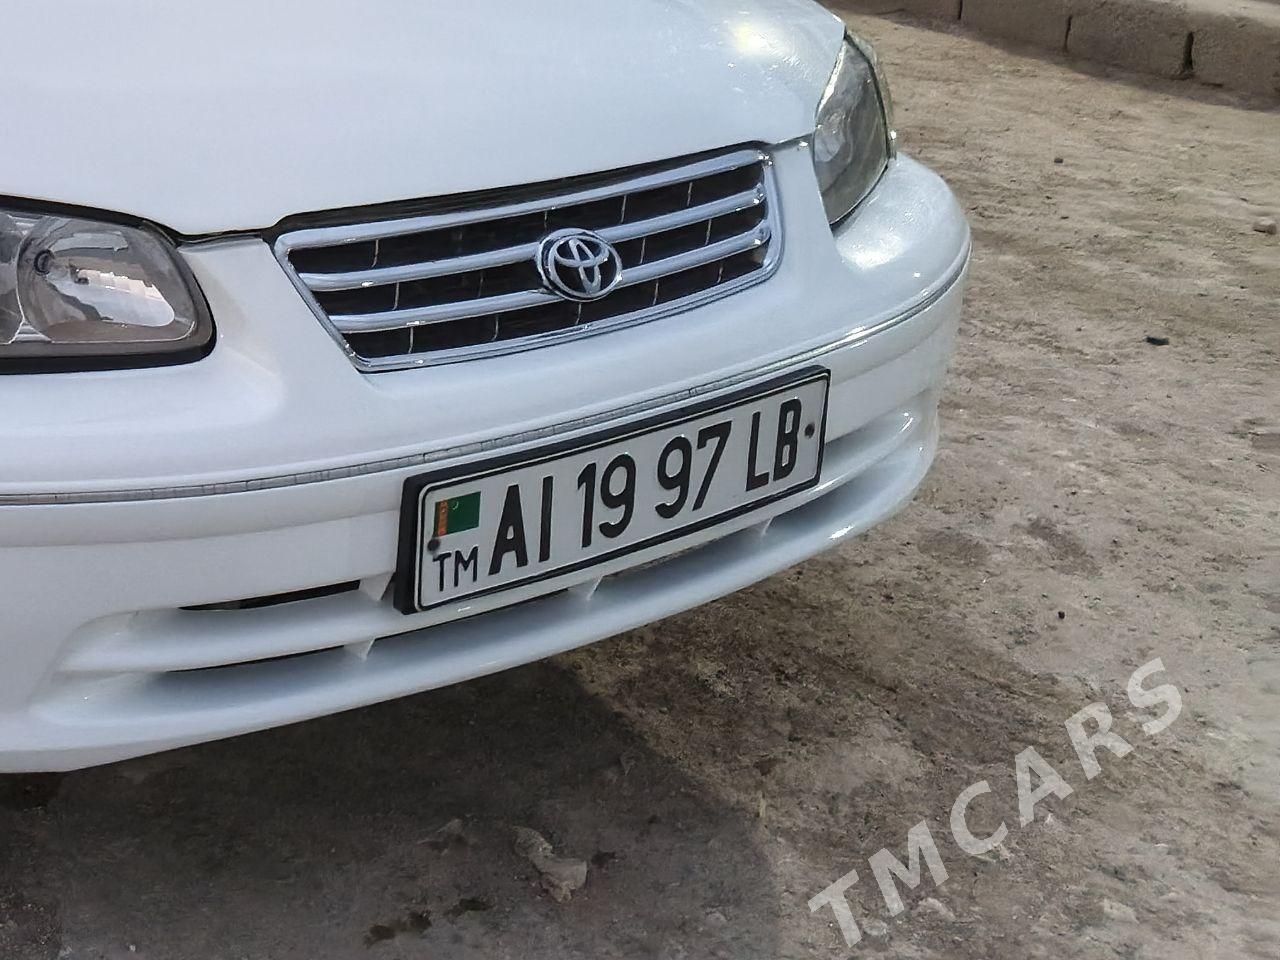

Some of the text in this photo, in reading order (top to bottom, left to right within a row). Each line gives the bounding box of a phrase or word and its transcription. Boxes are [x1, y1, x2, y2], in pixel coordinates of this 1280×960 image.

[488, 398, 802, 576] AI 19 97 LB
[432, 545, 479, 591] TM
